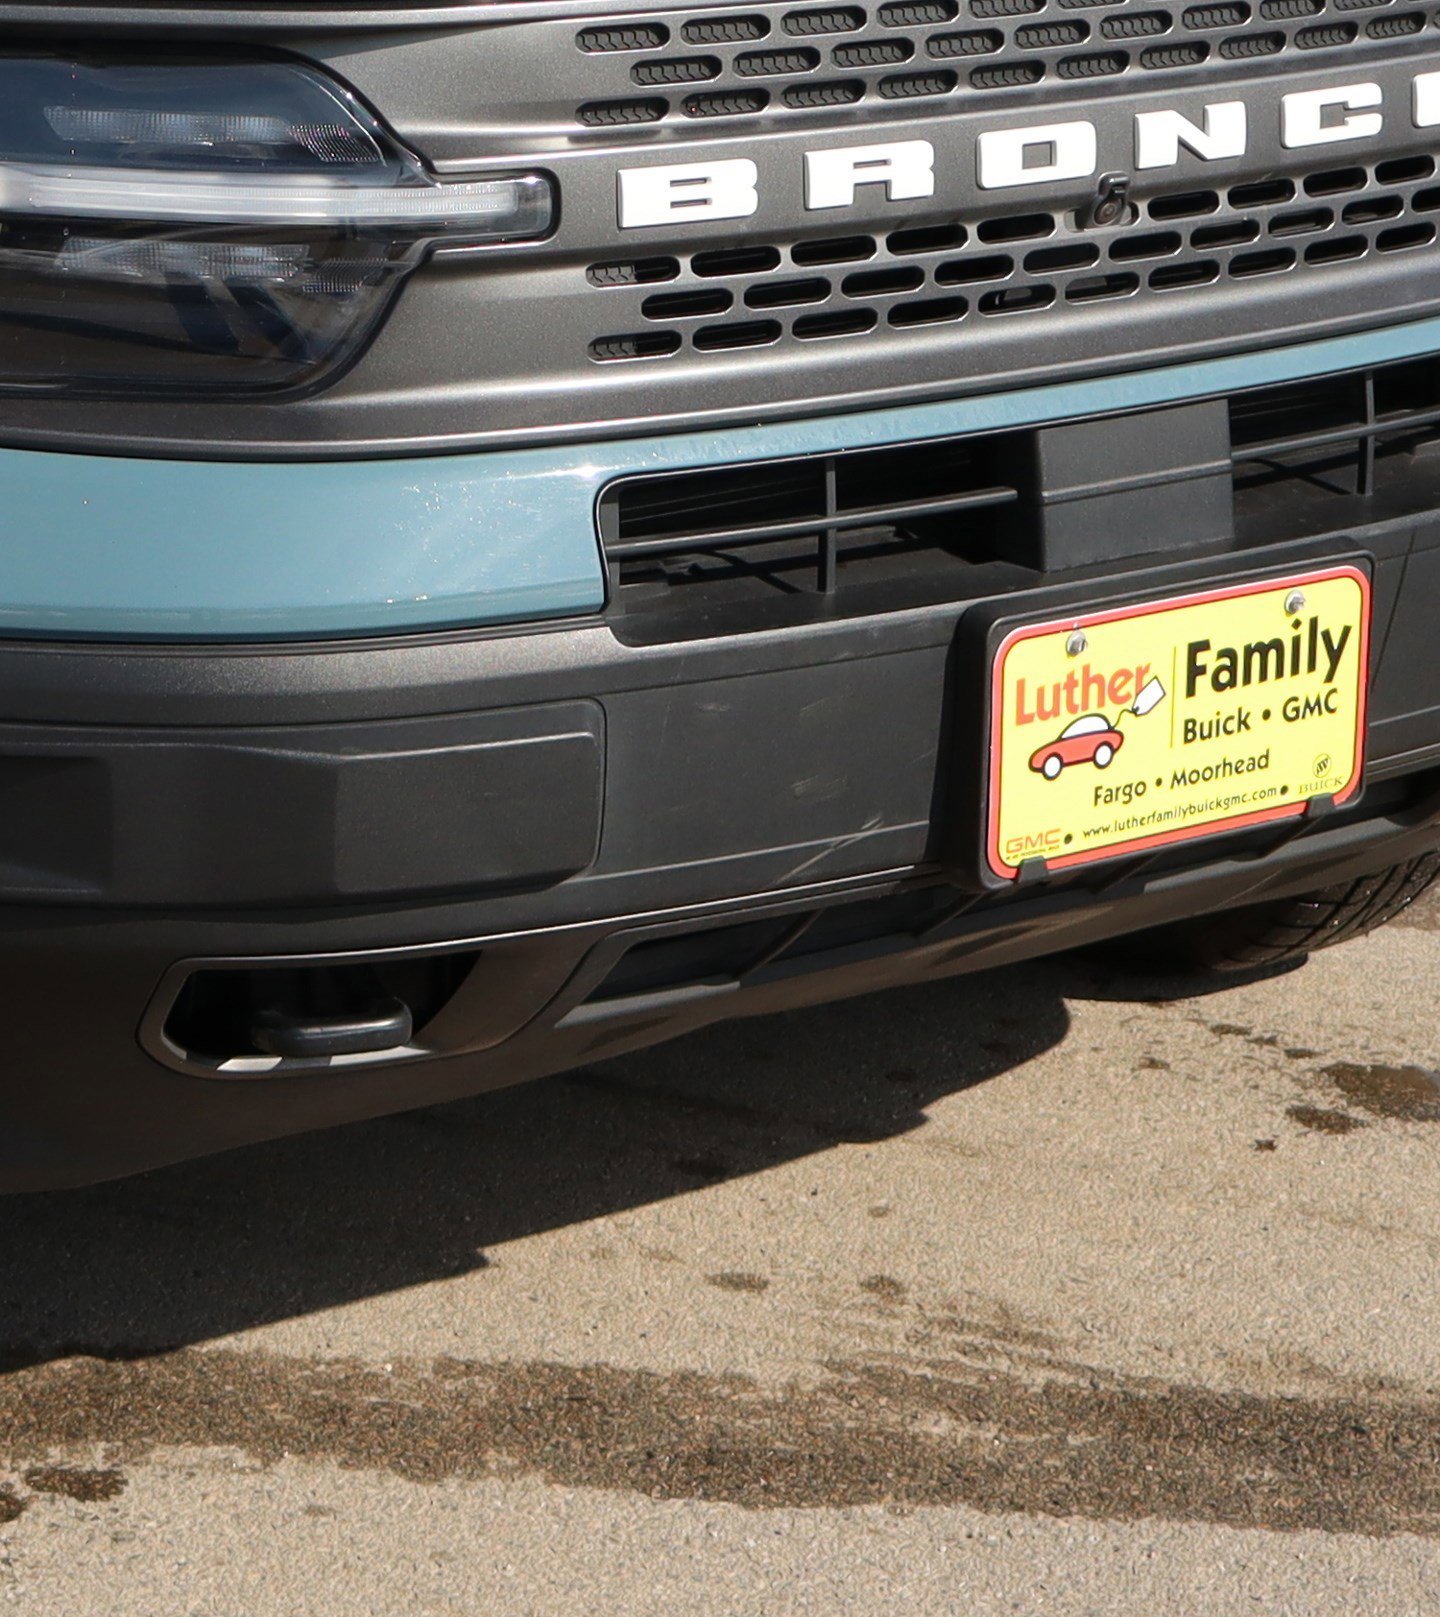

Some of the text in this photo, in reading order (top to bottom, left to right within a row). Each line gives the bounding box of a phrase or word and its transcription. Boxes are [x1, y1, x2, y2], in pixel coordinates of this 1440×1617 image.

[1185, 615, 1353, 700] Family
[1015, 662, 1152, 727] Luther
[1182, 687, 1339, 745] Buick GMC
[1093, 748, 1271, 808] Fargo Moorhead
[1298, 775, 1344, 795] BUICK
[1005, 827, 1062, 854] GMC
[1082, 786, 1278, 839] www.lutherfamilybuickgmc.com
